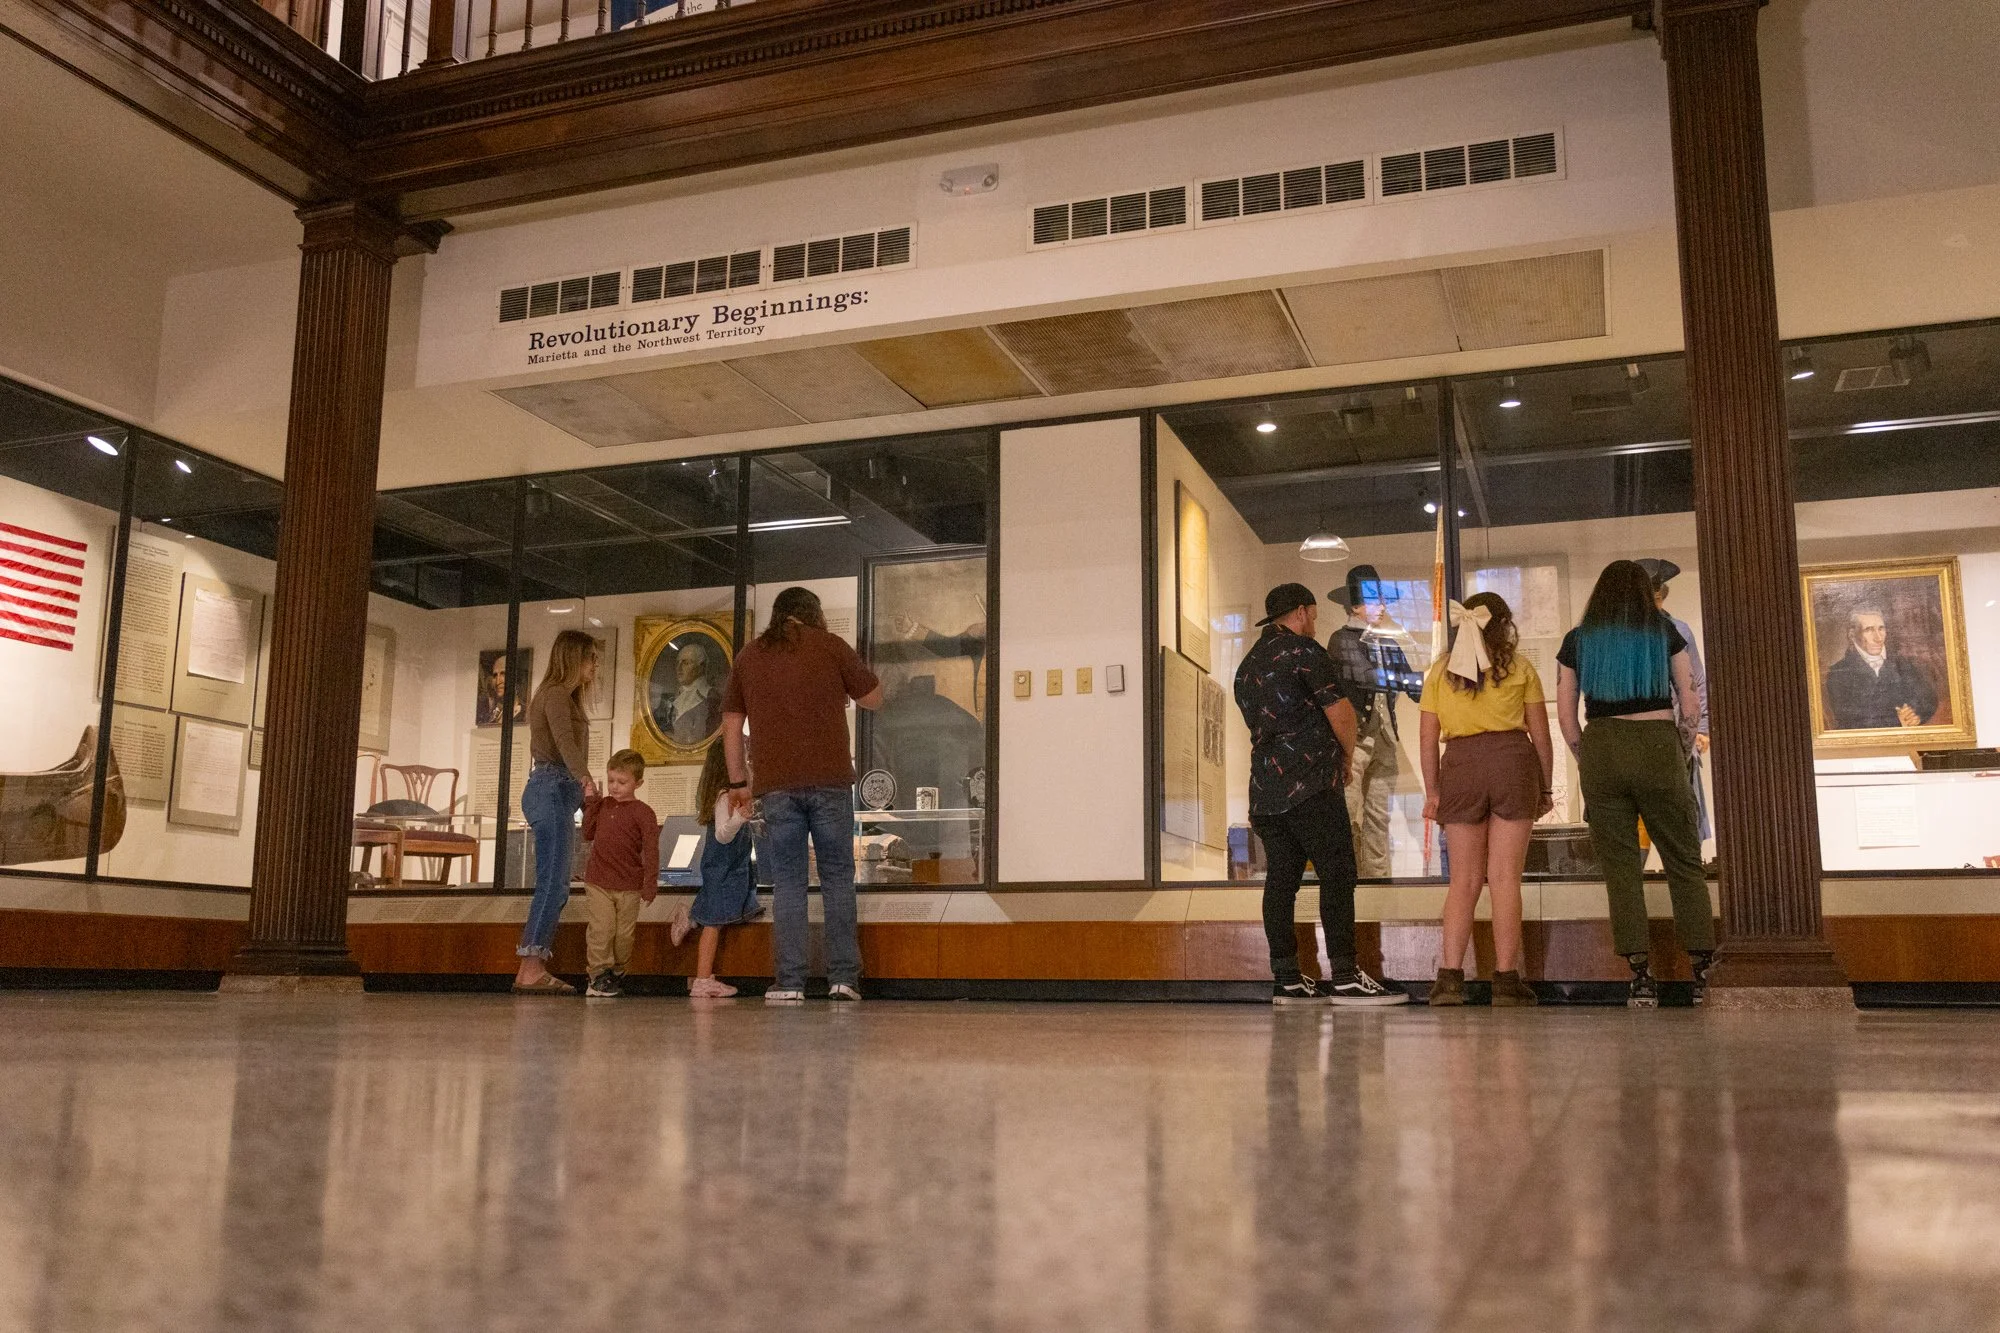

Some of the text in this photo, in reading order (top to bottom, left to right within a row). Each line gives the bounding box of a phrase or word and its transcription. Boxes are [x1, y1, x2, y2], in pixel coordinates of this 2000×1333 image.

[527, 325, 765, 365] Marietta and the Northwest Territory
[528, 290, 869, 351] Revolutionary Beginnings:
